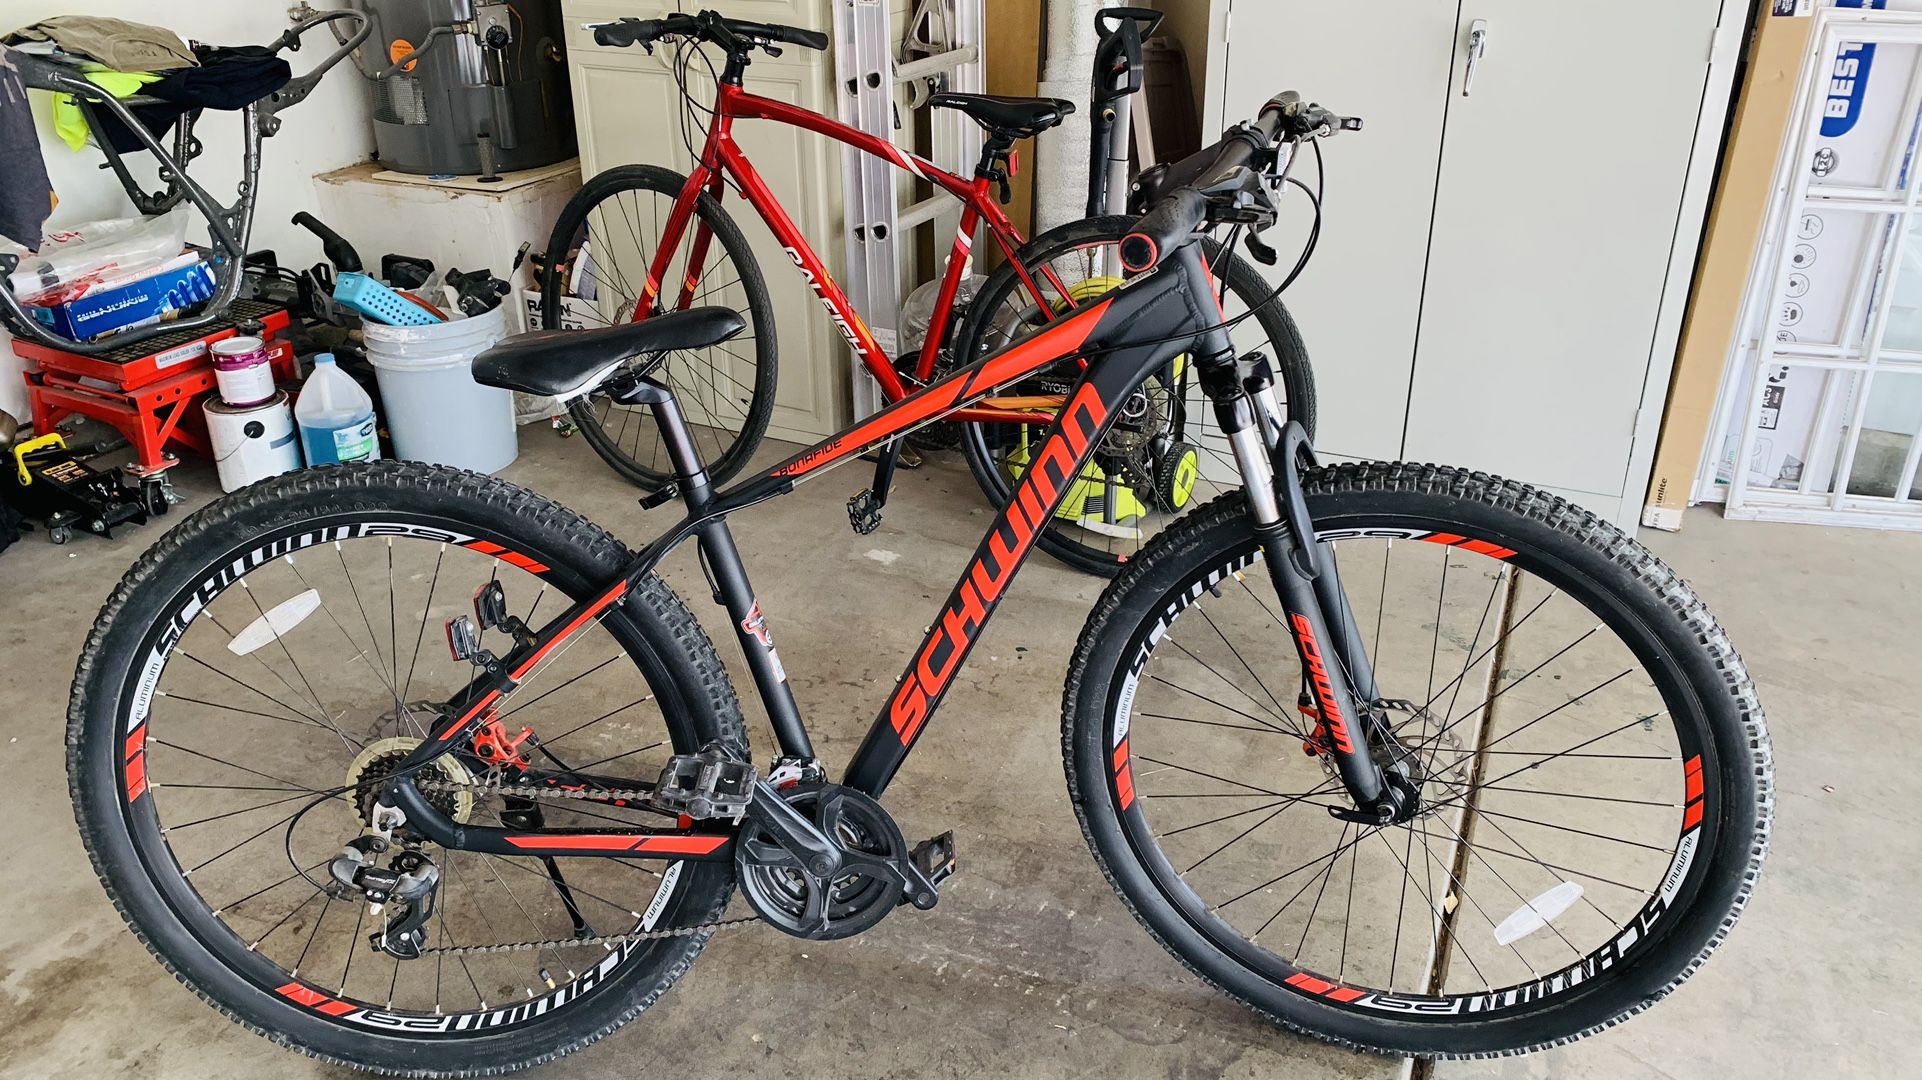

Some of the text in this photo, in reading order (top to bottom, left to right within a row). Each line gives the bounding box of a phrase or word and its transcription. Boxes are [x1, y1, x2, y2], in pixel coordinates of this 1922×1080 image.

[785, 247, 868, 354] RALEIGH
[1041, 380, 1071, 395] RYOBI
[780, 440, 843, 476] BONAFIDE
[156, 523, 361, 660] SCHWINN
[891, 382, 1108, 747] SCHWINN
[135, 662, 160, 720] ALUMINUM
[1292, 612, 1356, 755] SCHWINN
[646, 866, 677, 920] ALUMINUM
[1664, 835, 1694, 894] ALUMINUM
